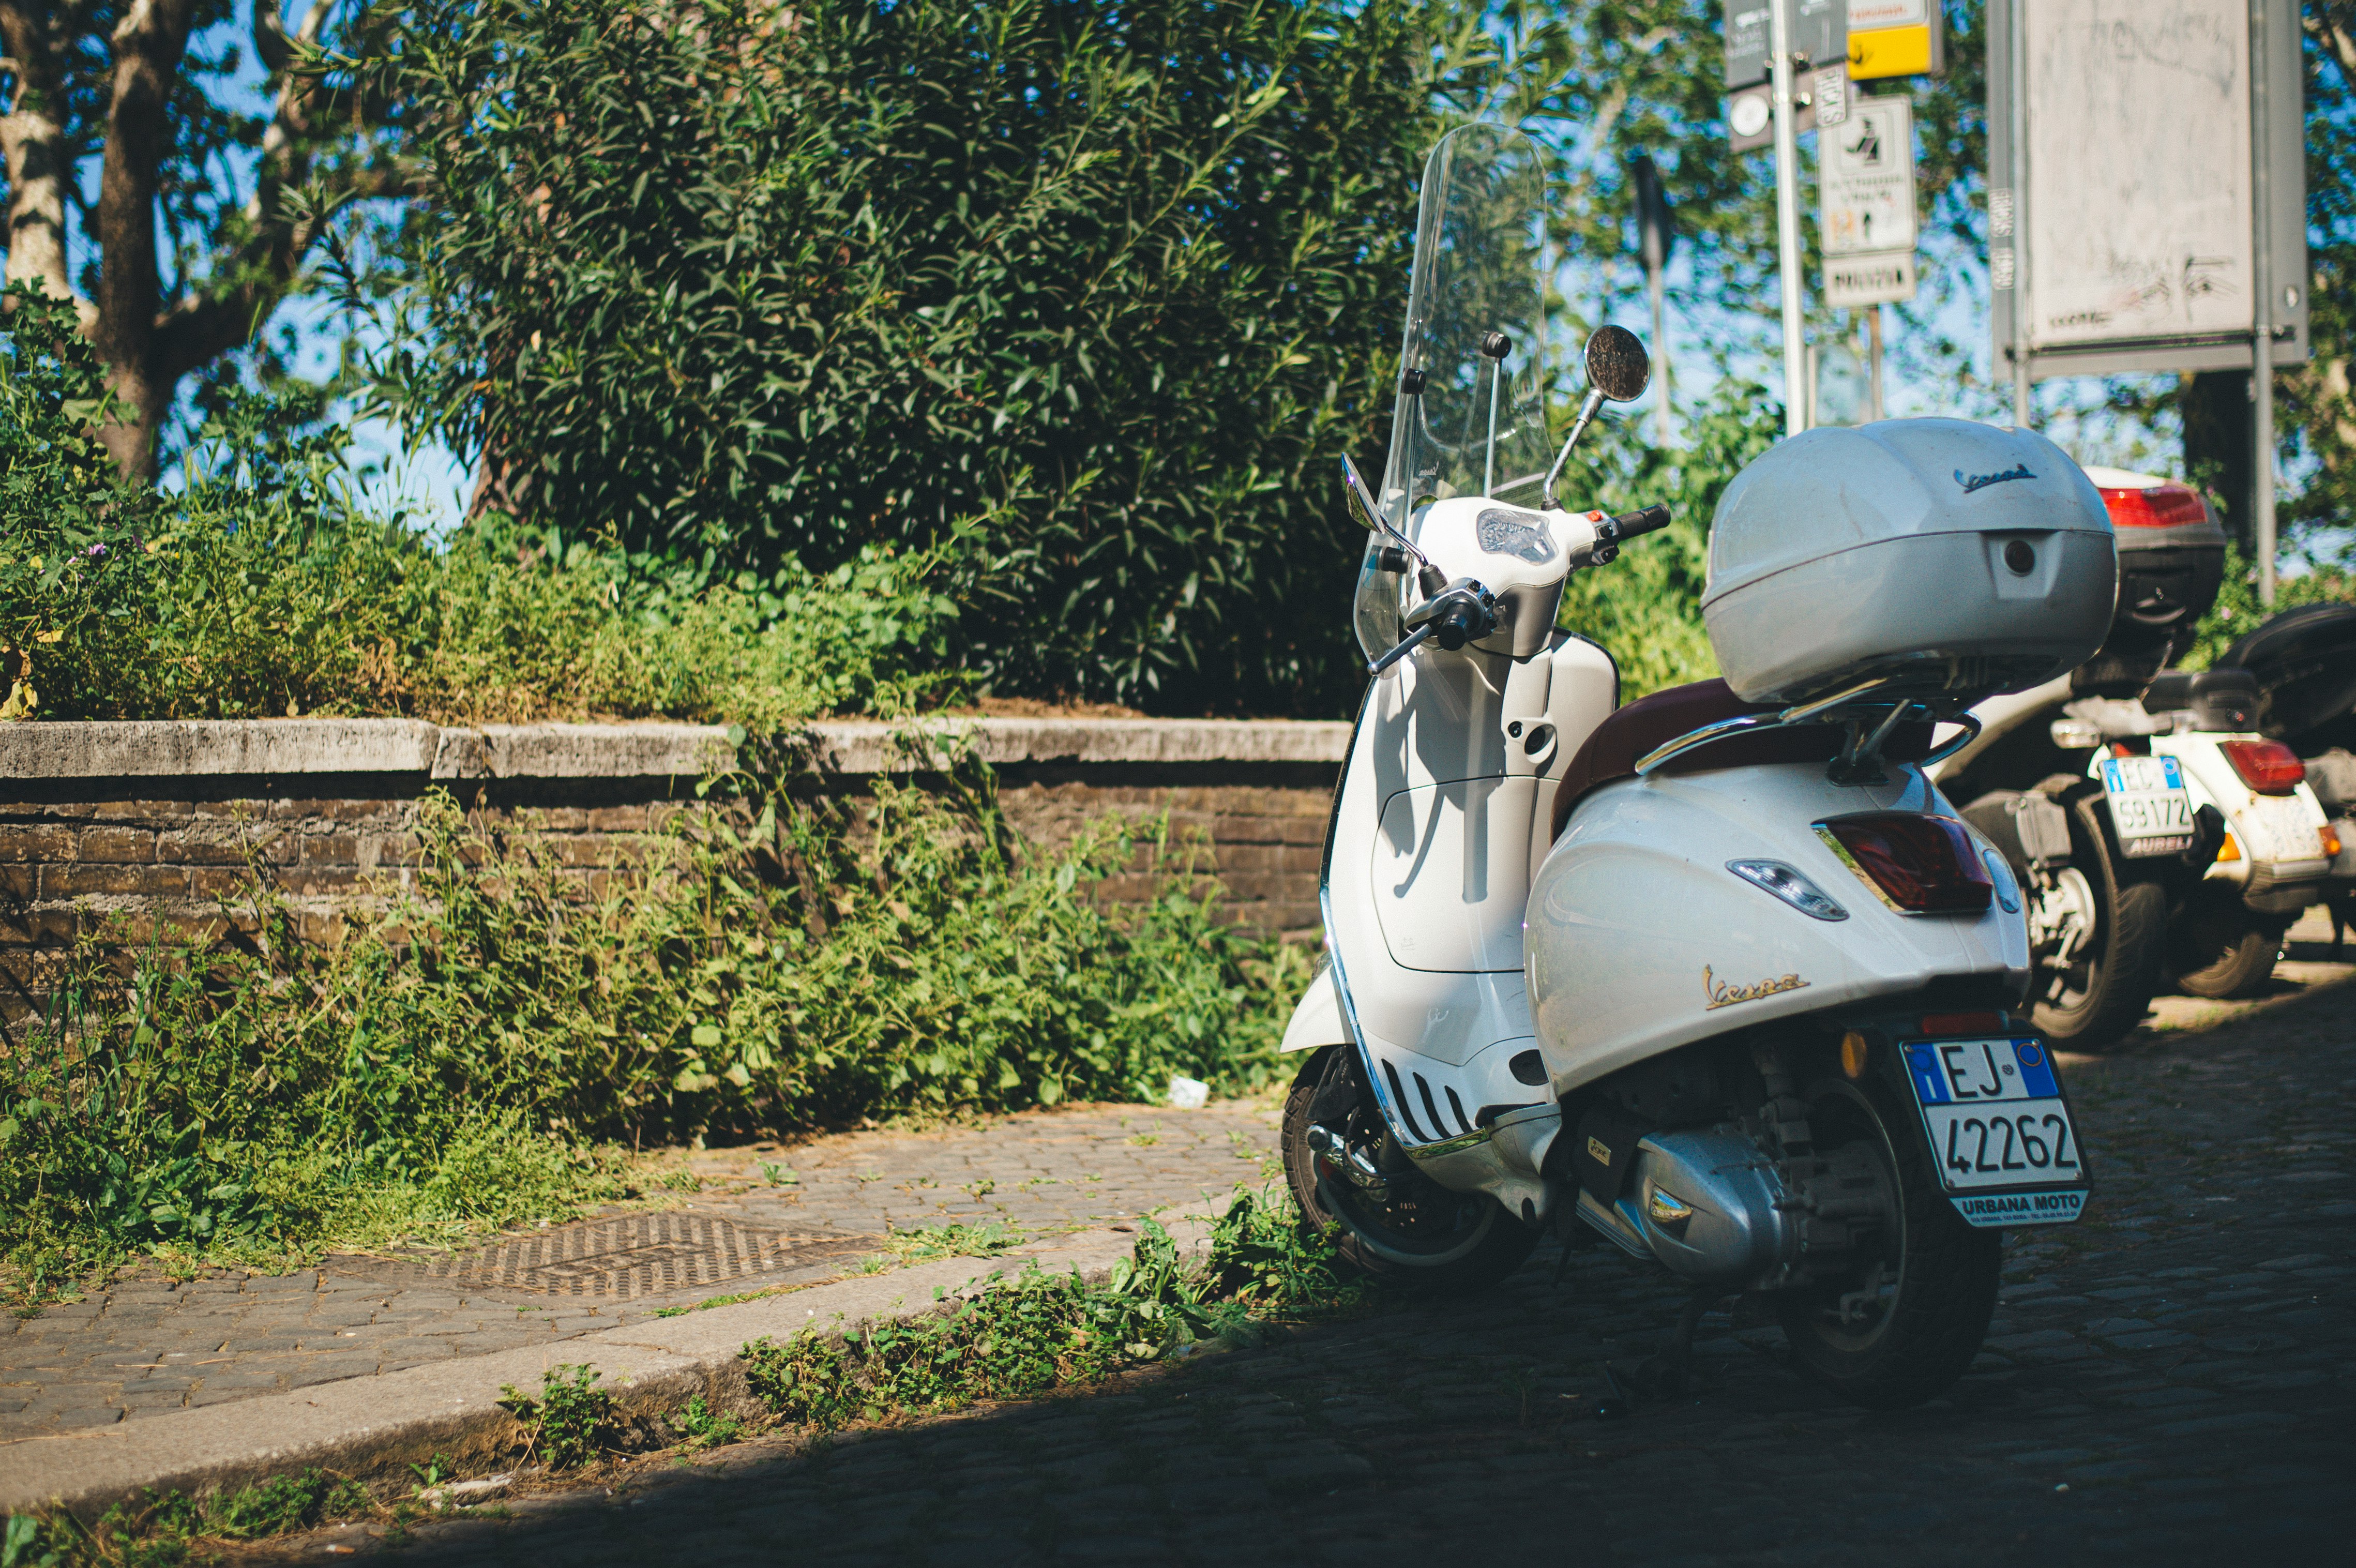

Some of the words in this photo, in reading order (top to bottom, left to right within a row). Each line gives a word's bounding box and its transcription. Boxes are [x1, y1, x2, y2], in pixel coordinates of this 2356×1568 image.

[1953, 463, 2037, 493] Vespa
[2123, 759, 2152, 791] EC
[2120, 797, 2190, 827] 59172
[2130, 836, 2193, 853] AURELI
[1702, 964, 1811, 1011] Vespa
[1939, 1044, 2002, 1097] EJ
[1946, 1114, 2076, 1173] 42262
[1962, 1197, 2030, 1214] URBANA
[2034, 1194, 2080, 1210] MOTO
